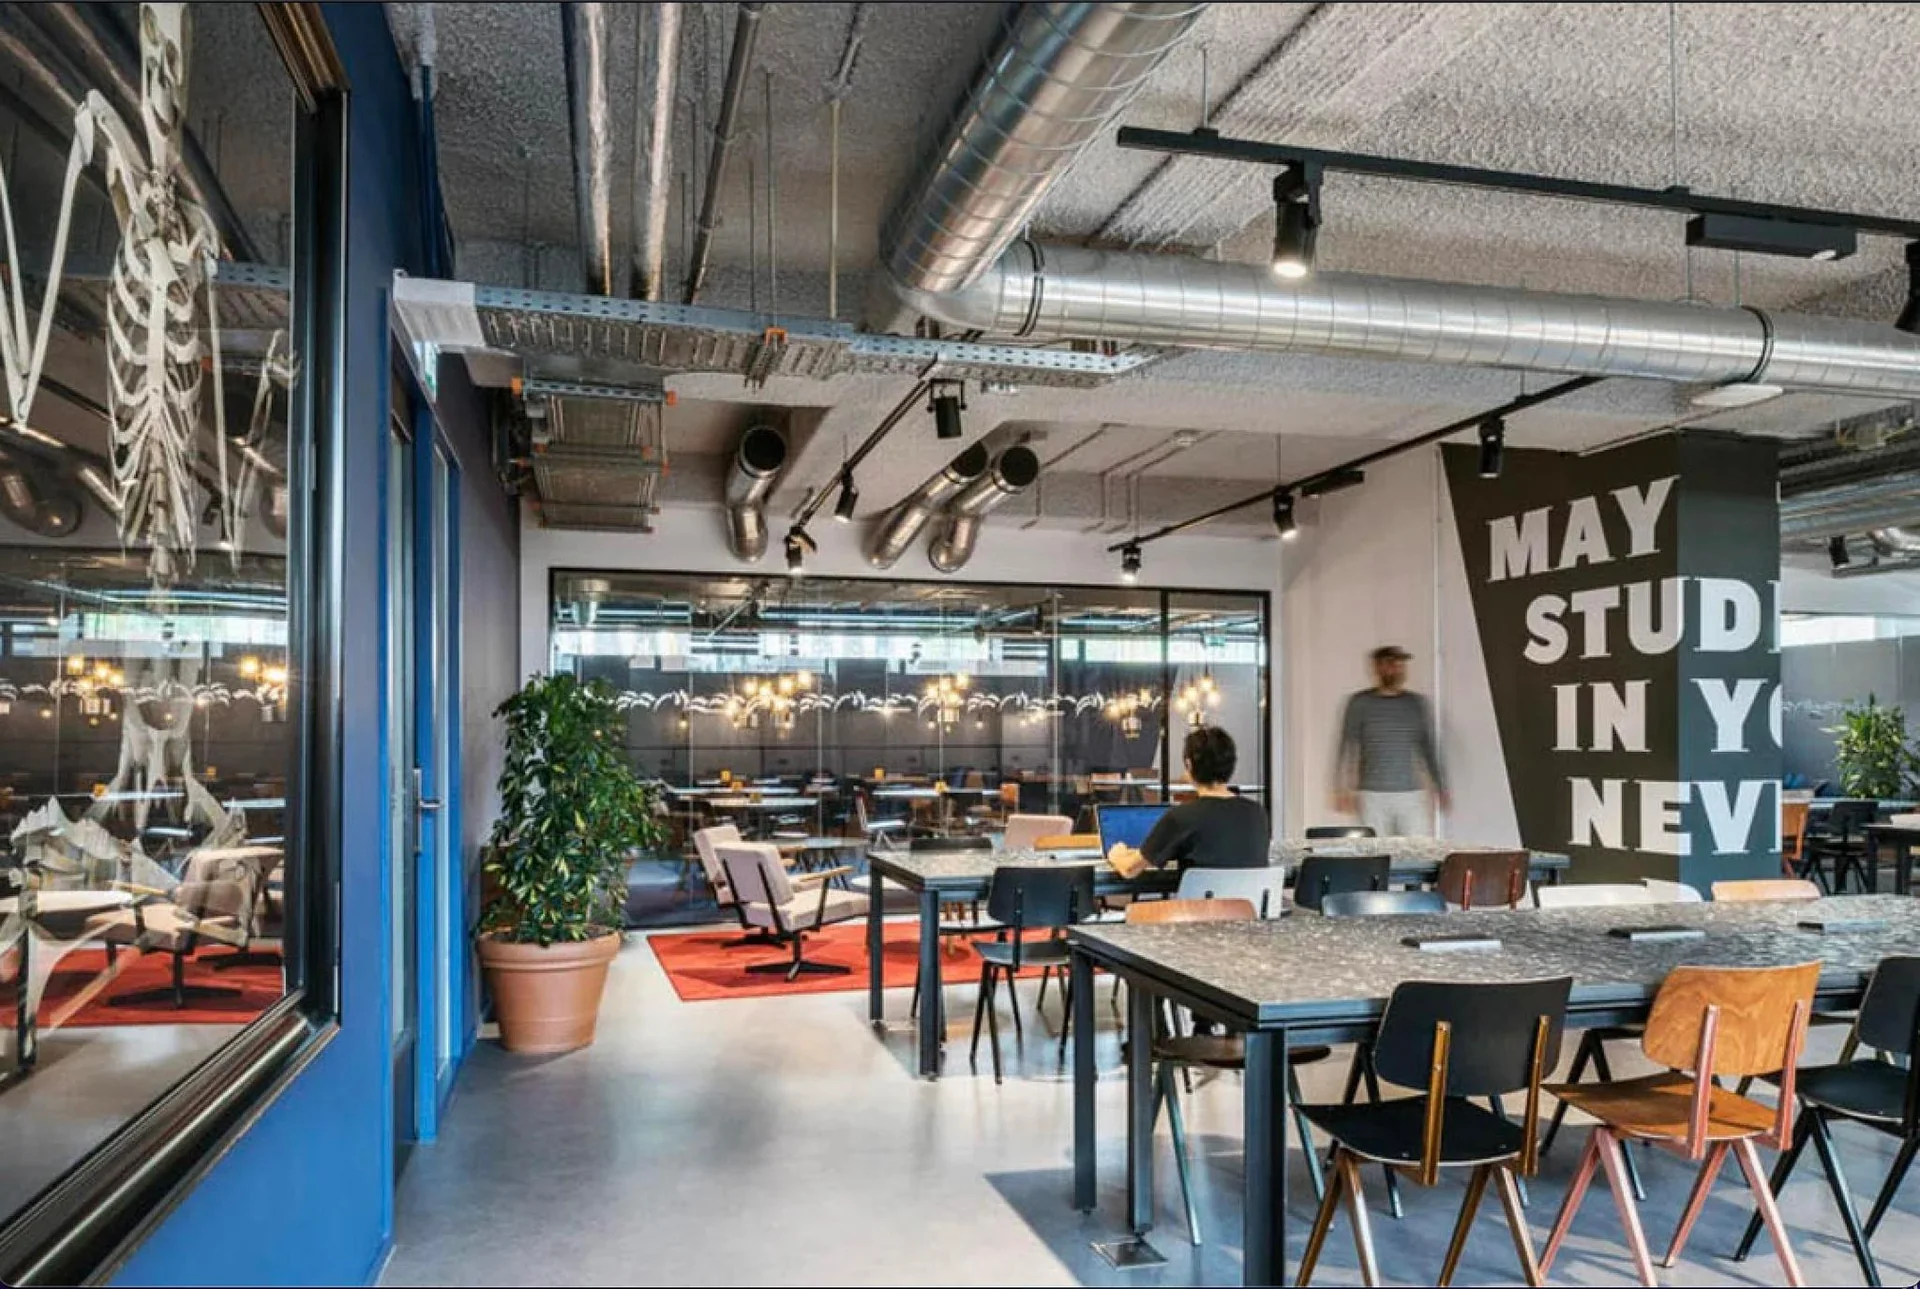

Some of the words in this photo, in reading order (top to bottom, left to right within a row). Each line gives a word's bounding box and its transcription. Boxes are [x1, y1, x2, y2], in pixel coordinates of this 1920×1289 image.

[1484, 475, 1681, 583] MAY
[1522, 576, 1782, 665] STUD
[1551, 679, 1652, 752] IN
[1565, 775, 1783, 856] NEV
